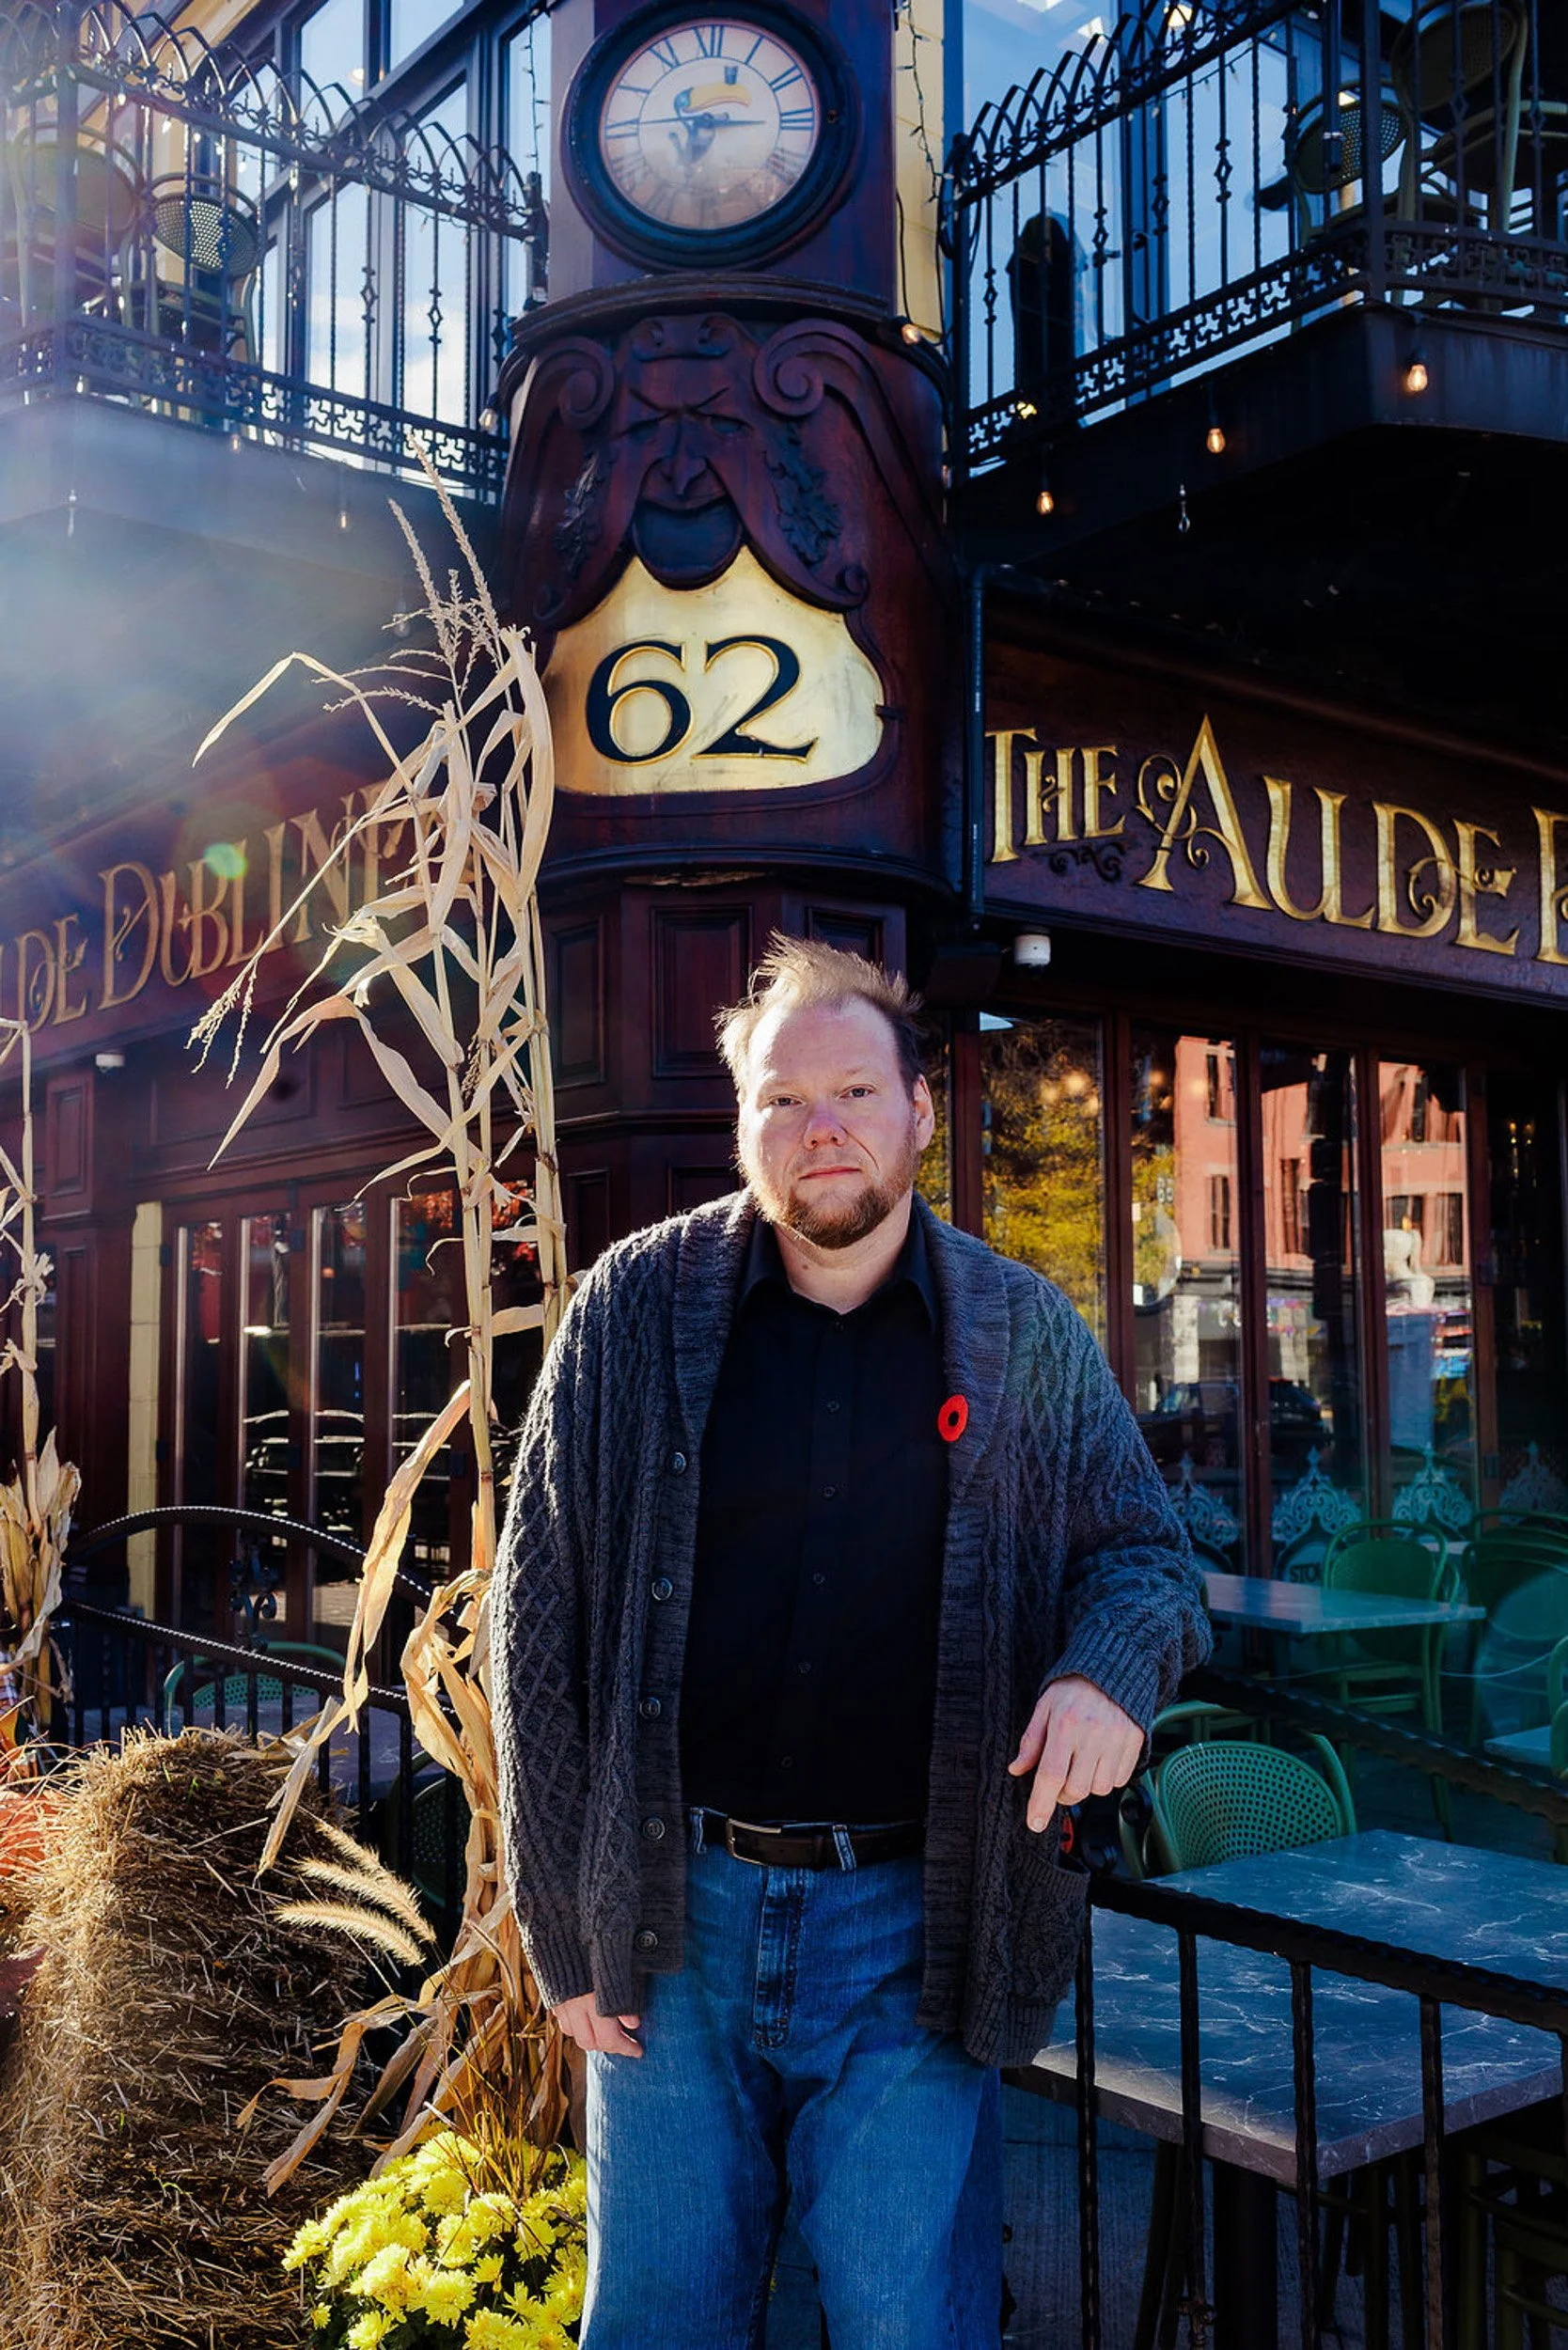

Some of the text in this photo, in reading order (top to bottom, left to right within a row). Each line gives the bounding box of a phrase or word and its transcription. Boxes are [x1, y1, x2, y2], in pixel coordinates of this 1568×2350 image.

[587, 634, 818, 767] 62
[98, 777, 485, 1010] DUBLINE
[1137, 713, 1519, 956] AULDE
